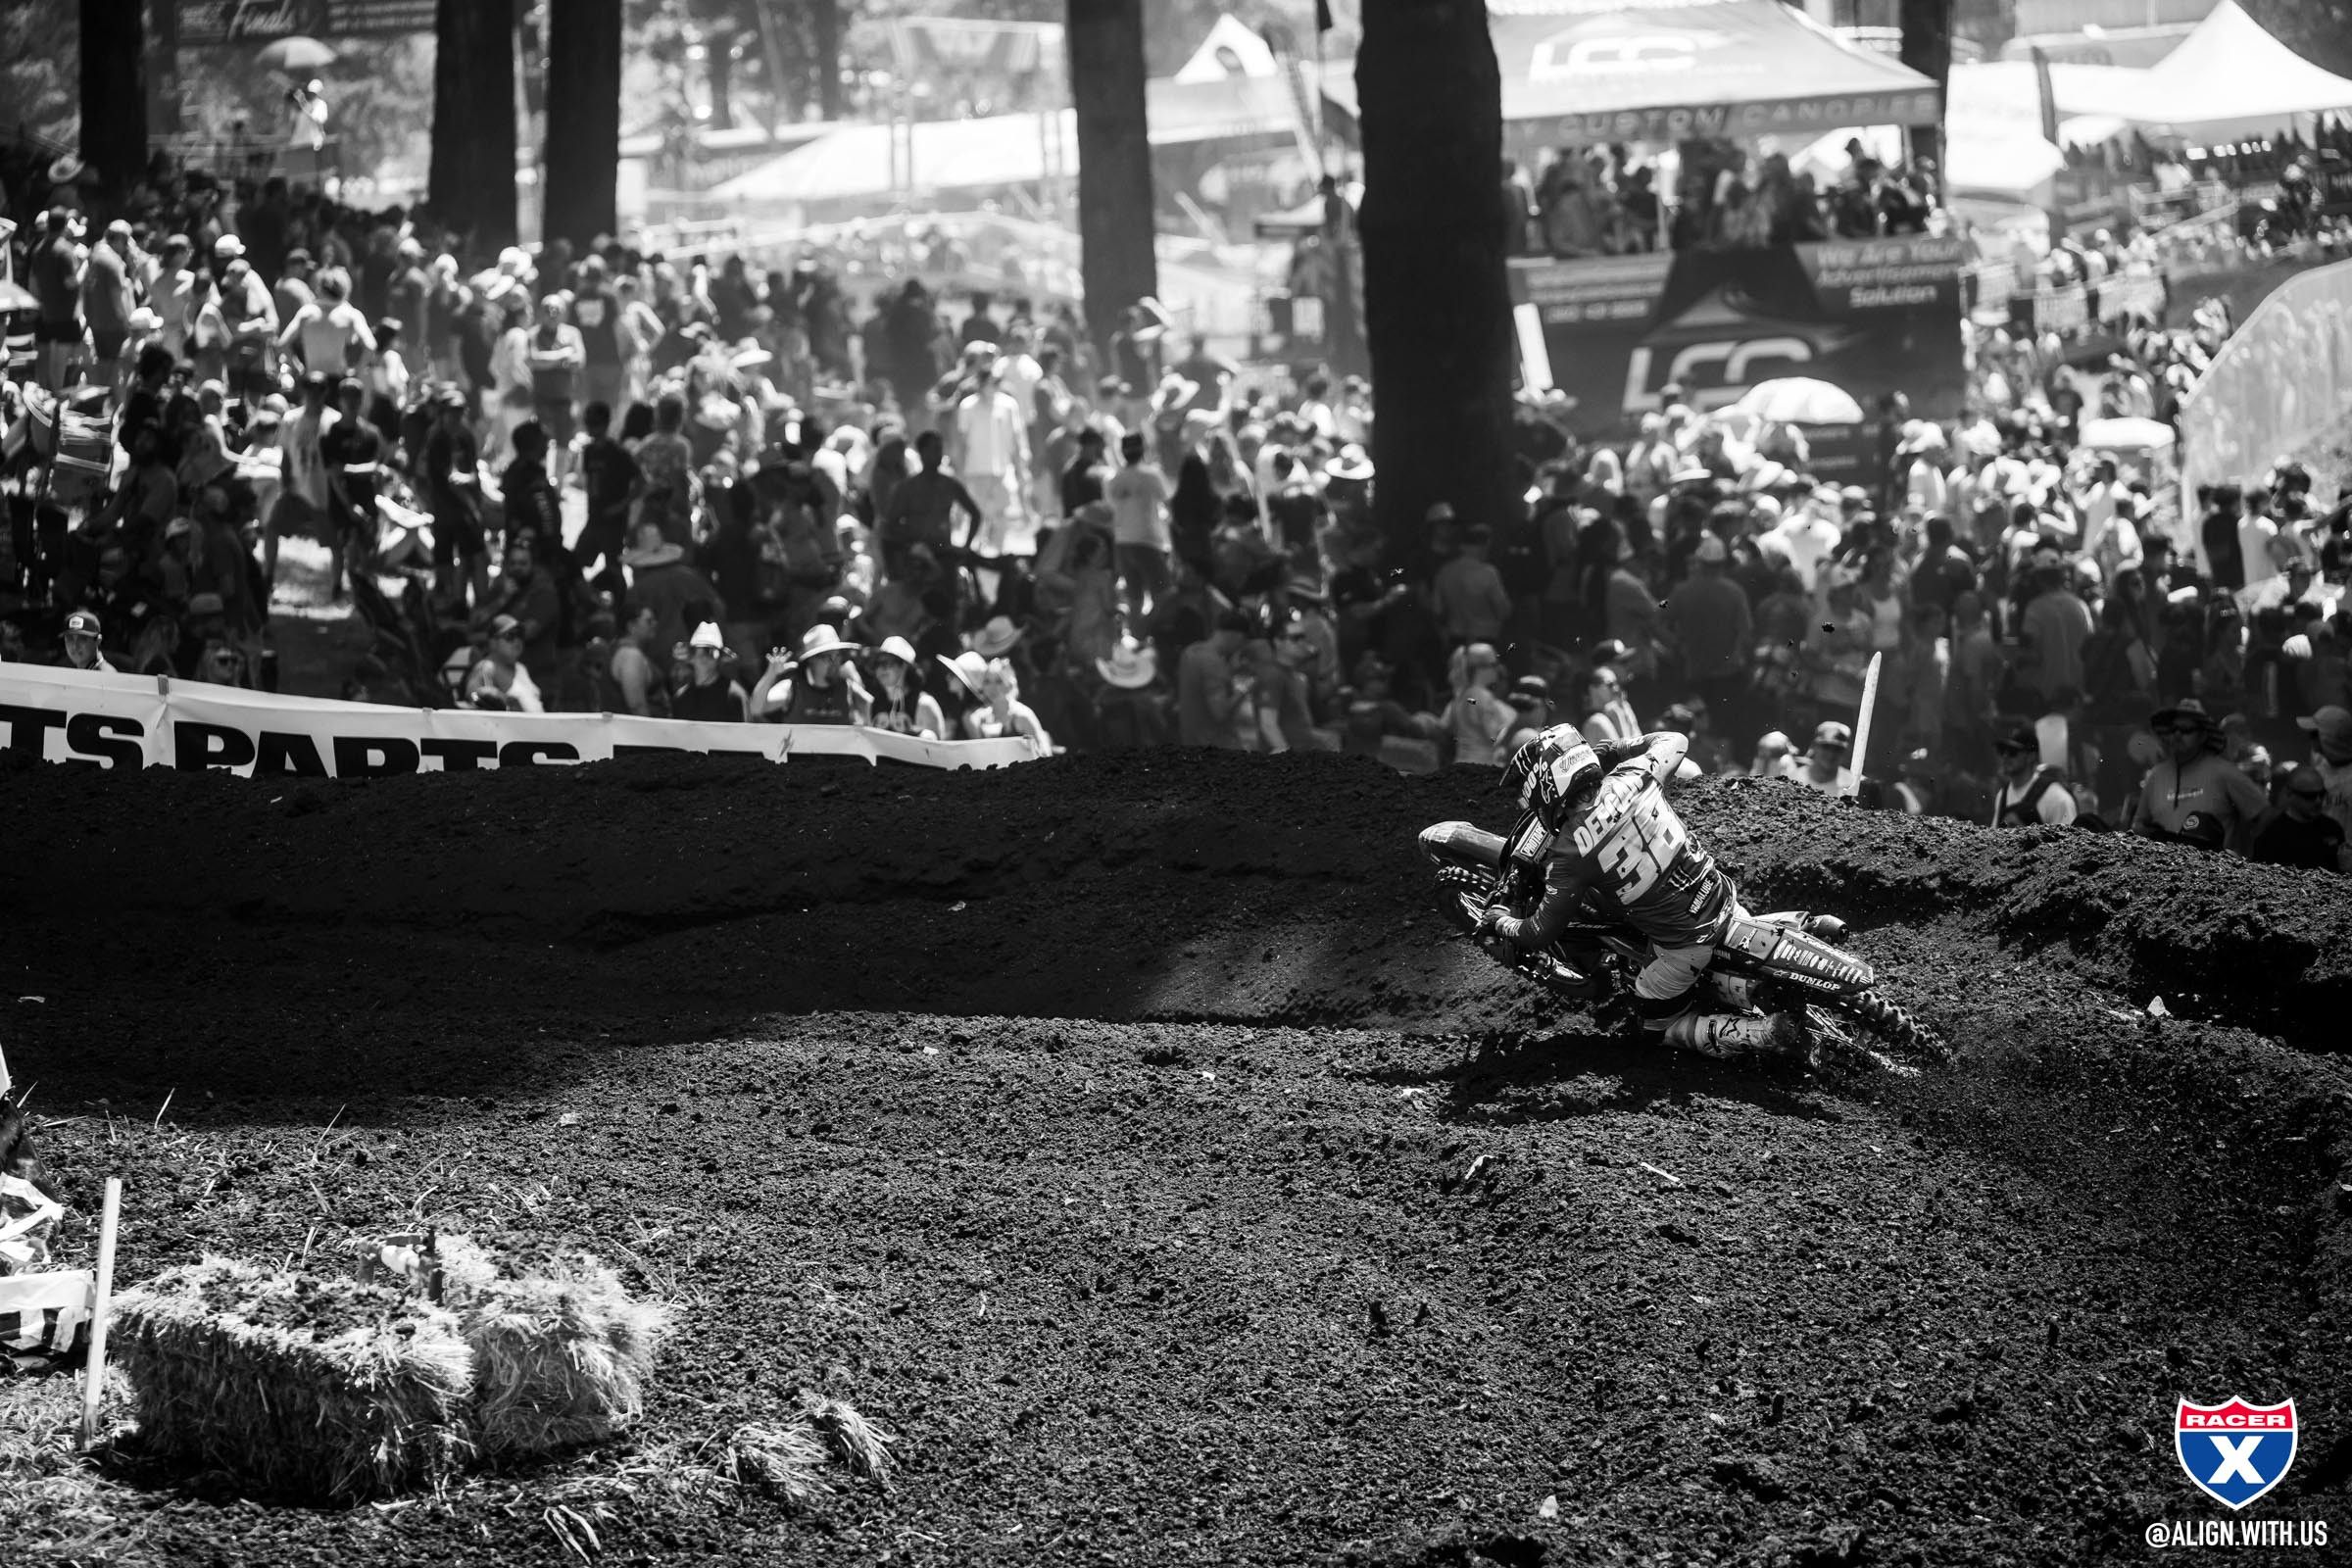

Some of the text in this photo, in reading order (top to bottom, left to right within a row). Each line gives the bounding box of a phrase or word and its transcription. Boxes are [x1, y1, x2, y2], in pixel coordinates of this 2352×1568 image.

[1557, 107, 1725, 140] CUSTOM
[1817, 245, 1855, 268] We
[1859, 244, 1902, 266] Are
[1850, 285, 1937, 308] Solution
[1573, 776, 1643, 858] DEEGAN
[1597, 780, 1687, 905] 38
[1689, 877, 1714, 914] YAMALUBE
[1788, 972, 1841, 991] DUNLOP
